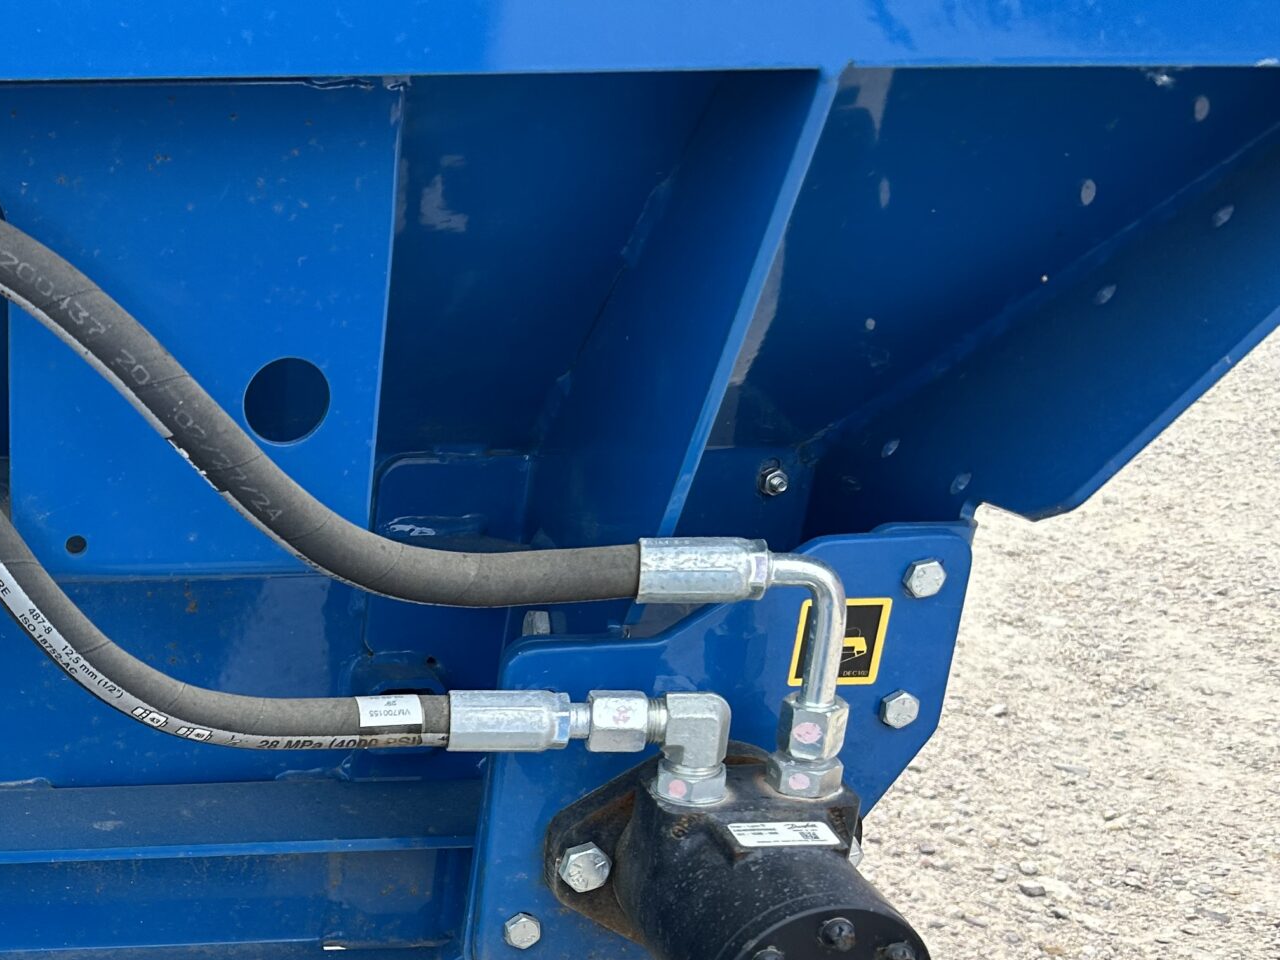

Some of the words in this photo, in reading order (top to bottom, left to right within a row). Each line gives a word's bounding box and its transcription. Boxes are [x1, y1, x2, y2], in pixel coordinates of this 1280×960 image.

[19, 614, 36, 632] ISO
[28, 608, 52, 634] 487-8
[62, 645, 81, 664] 12,5
[80, 663, 97, 680] mm
[256, 740, 280, 748] 28
[284, 740, 322, 748] MPa
